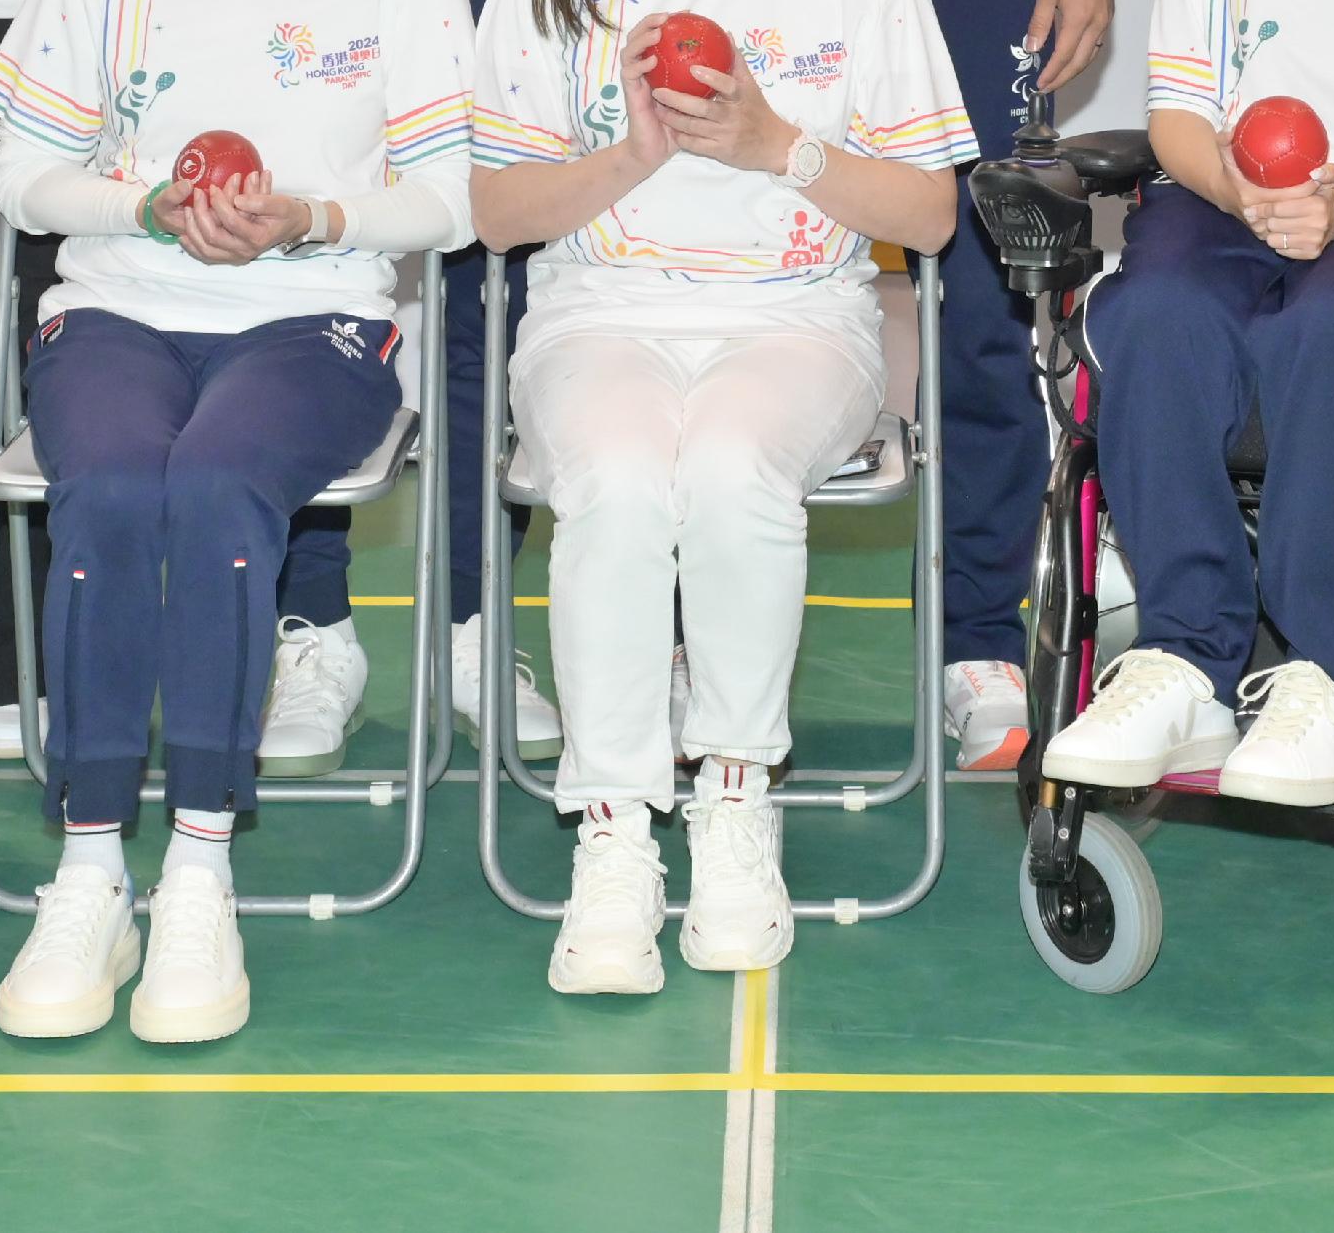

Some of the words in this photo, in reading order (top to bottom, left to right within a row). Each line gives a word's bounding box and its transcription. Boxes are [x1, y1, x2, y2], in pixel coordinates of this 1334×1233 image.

[348, 35, 380, 51] 2024
[819, 41, 844, 54] 202
[306, 68, 337, 79] HONG
[337, 62, 365, 75] KONG
[325, 70, 372, 85] PARALYMPIC
[780, 69, 811, 80] HONG
[811, 65, 838, 76] KONG
[342, 81, 357, 90] DAY
[816, 83, 830, 91] DAY
